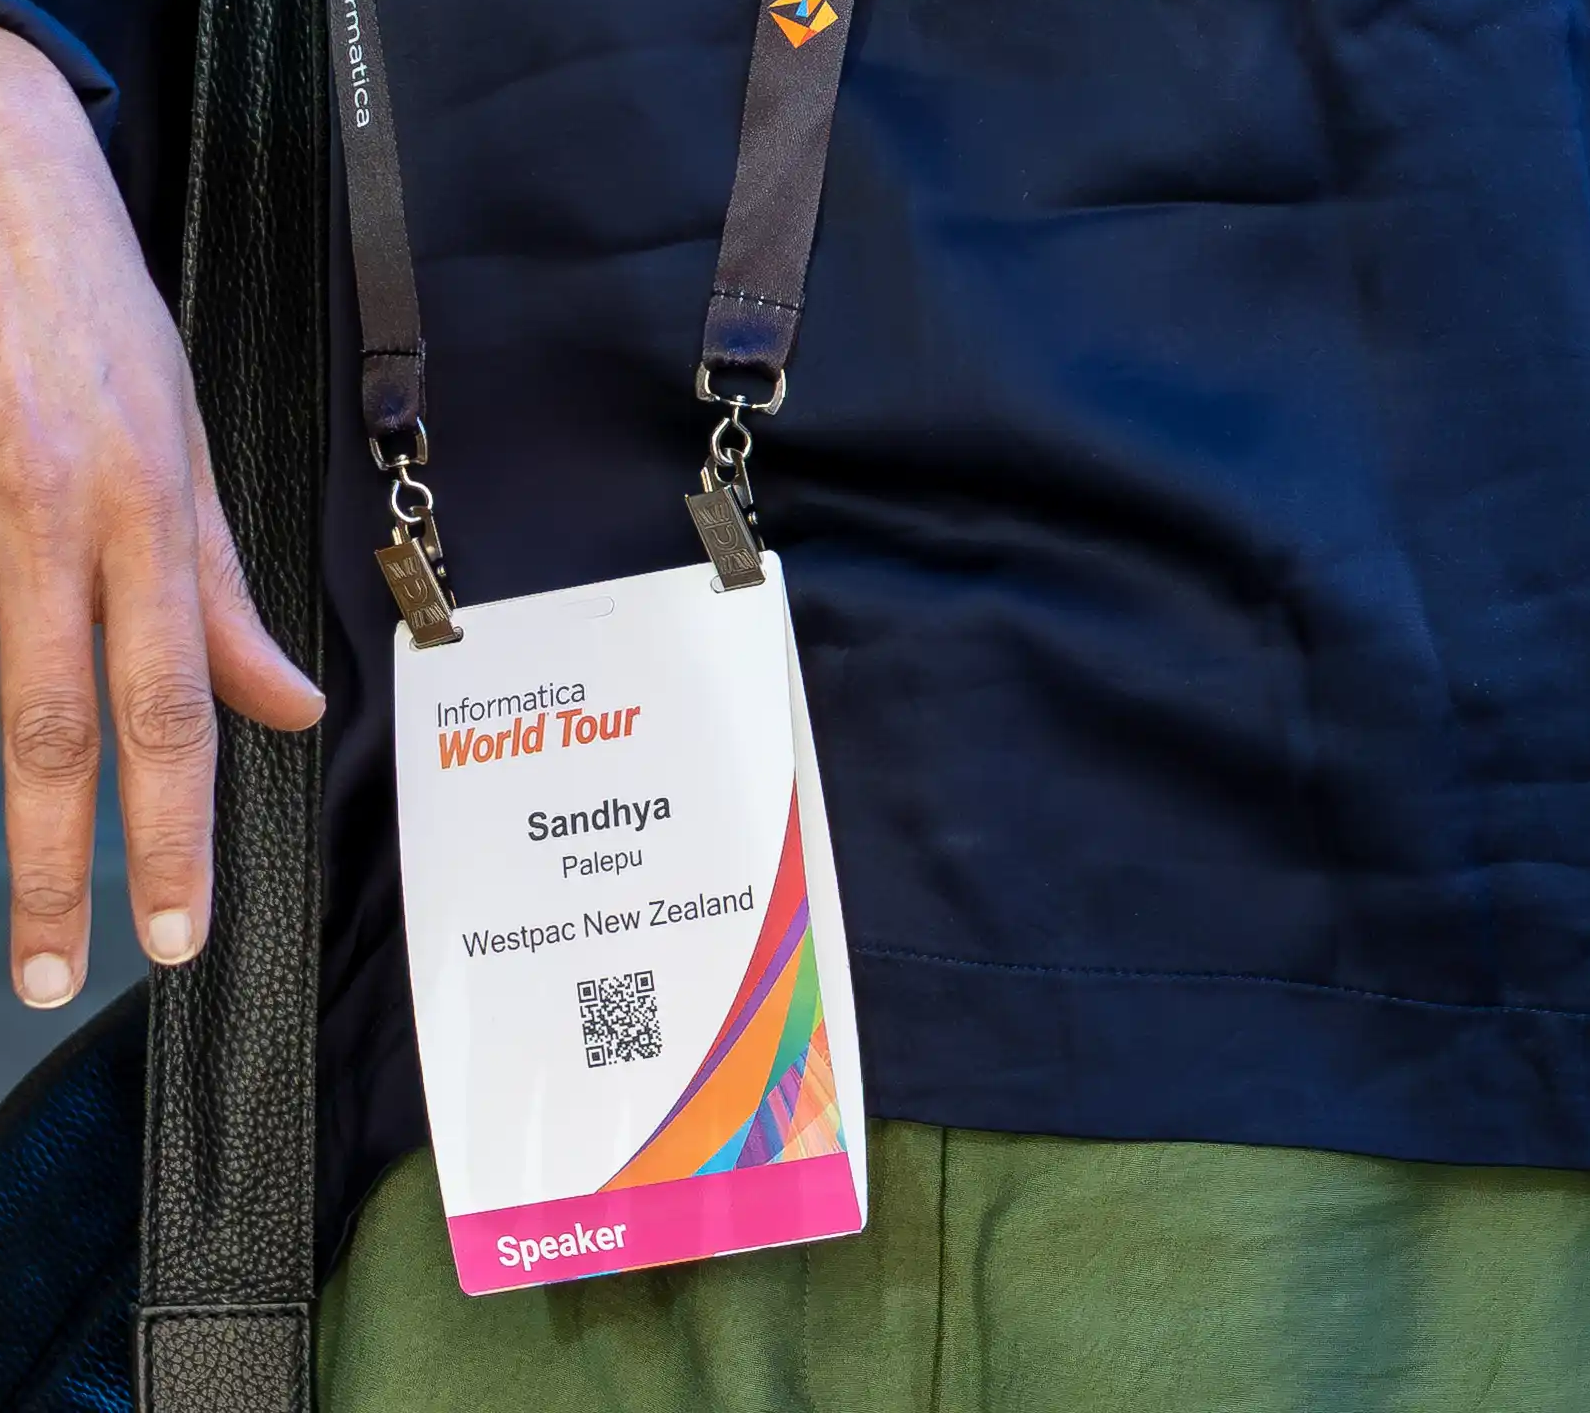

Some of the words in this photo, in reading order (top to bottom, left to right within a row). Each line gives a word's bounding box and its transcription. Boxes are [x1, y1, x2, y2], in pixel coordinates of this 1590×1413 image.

[436, 681, 586, 728] Informatica
[438, 712, 546, 770] World
[555, 705, 641, 748] Tour
[527, 795, 671, 842] Sandhya
[562, 849, 643, 879] Palepu
[462, 921, 576, 958] Westpac
[583, 910, 641, 937] New
[648, 884, 754, 928] Zealand
[496, 1222, 627, 1272] Speaker
